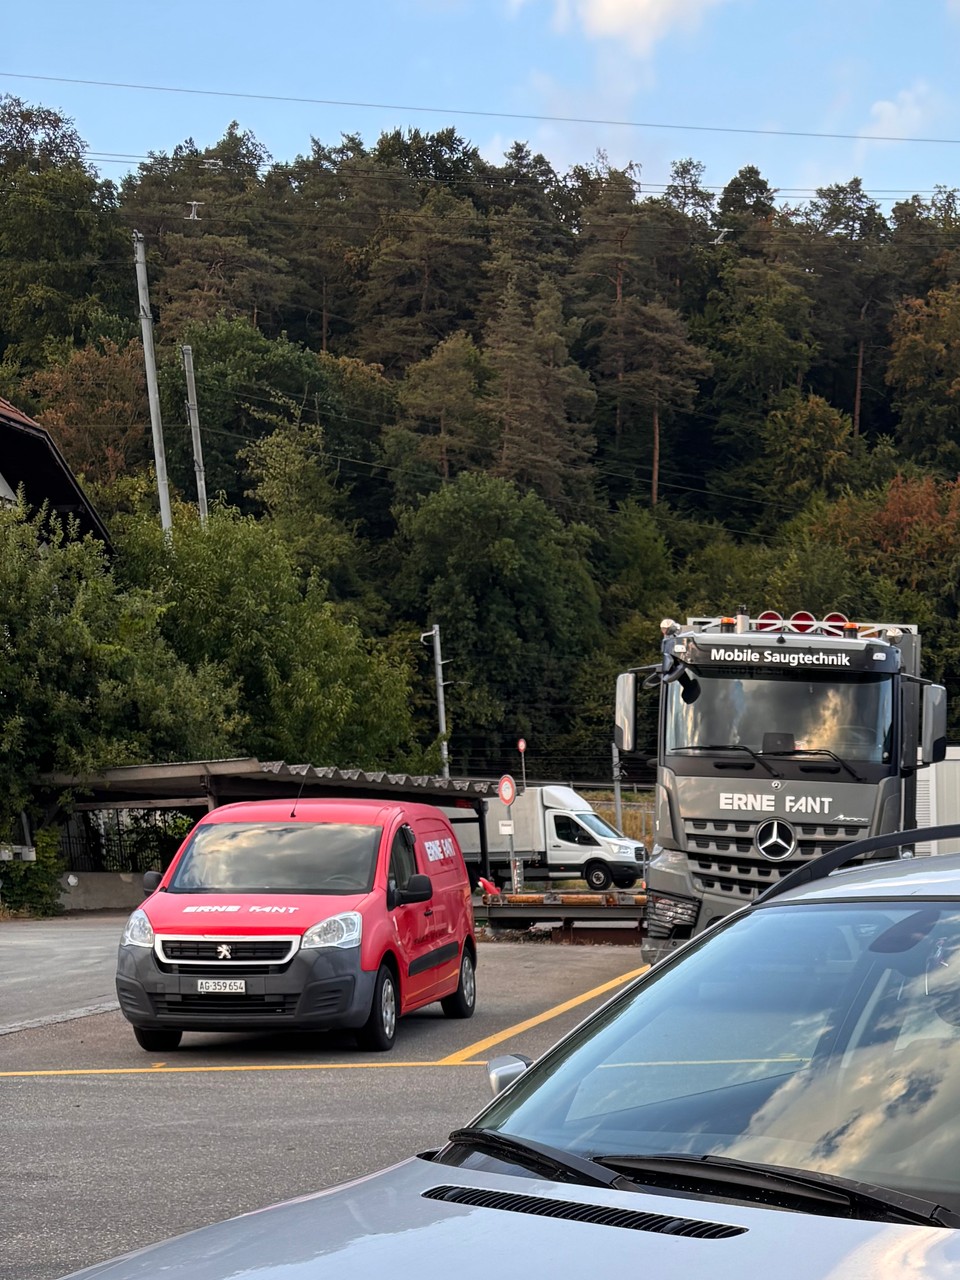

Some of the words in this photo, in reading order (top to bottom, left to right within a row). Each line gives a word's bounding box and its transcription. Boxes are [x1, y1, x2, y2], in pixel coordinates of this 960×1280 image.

[710, 648, 760, 662] Mobile
[763, 650, 851, 667] Saugtechnik
[719, 793, 775, 811] ERNE
[785, 796, 833, 814] FANT
[182, 905, 242, 913] ERNE
[248, 905, 300, 914] FANT
